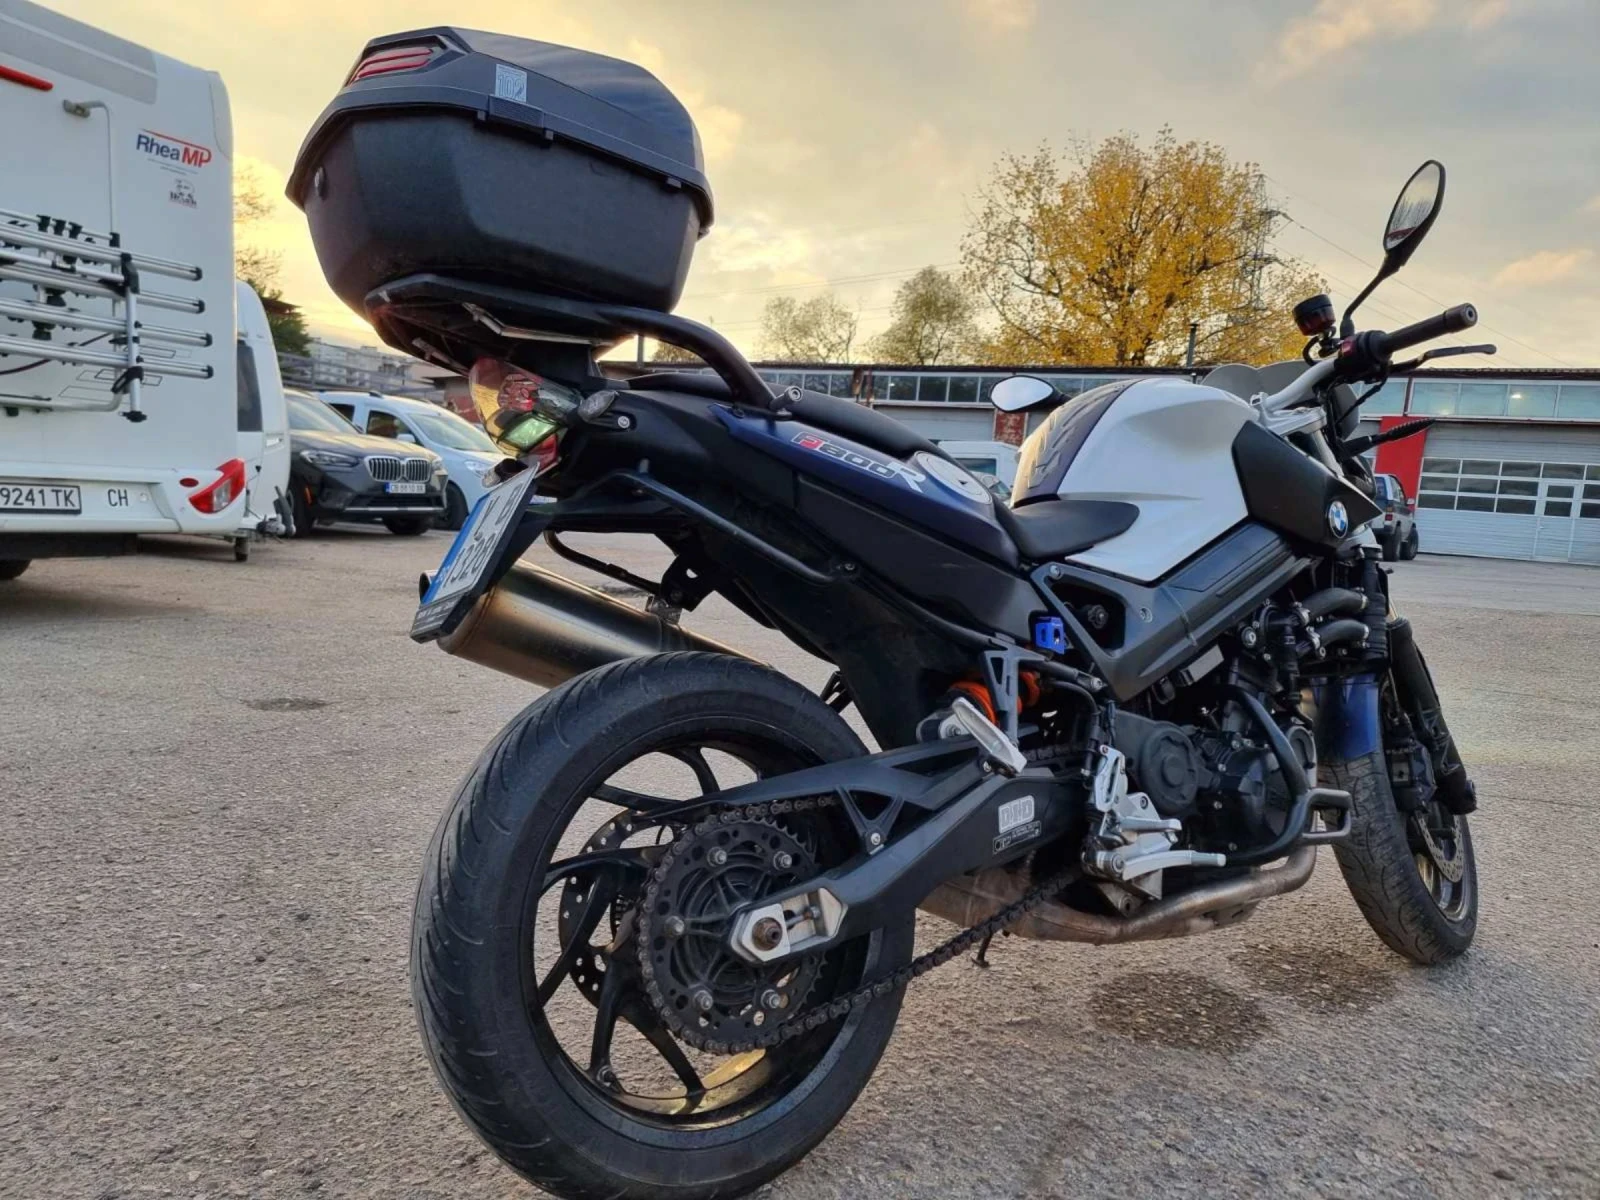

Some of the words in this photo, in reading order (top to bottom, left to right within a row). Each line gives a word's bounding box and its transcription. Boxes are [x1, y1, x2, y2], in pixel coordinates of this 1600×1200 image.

[0, 487, 46, 507] 9241
[51, 489, 76, 508] TK
[107, 488, 129, 507] CH
[443, 533, 496, 589] 1328
